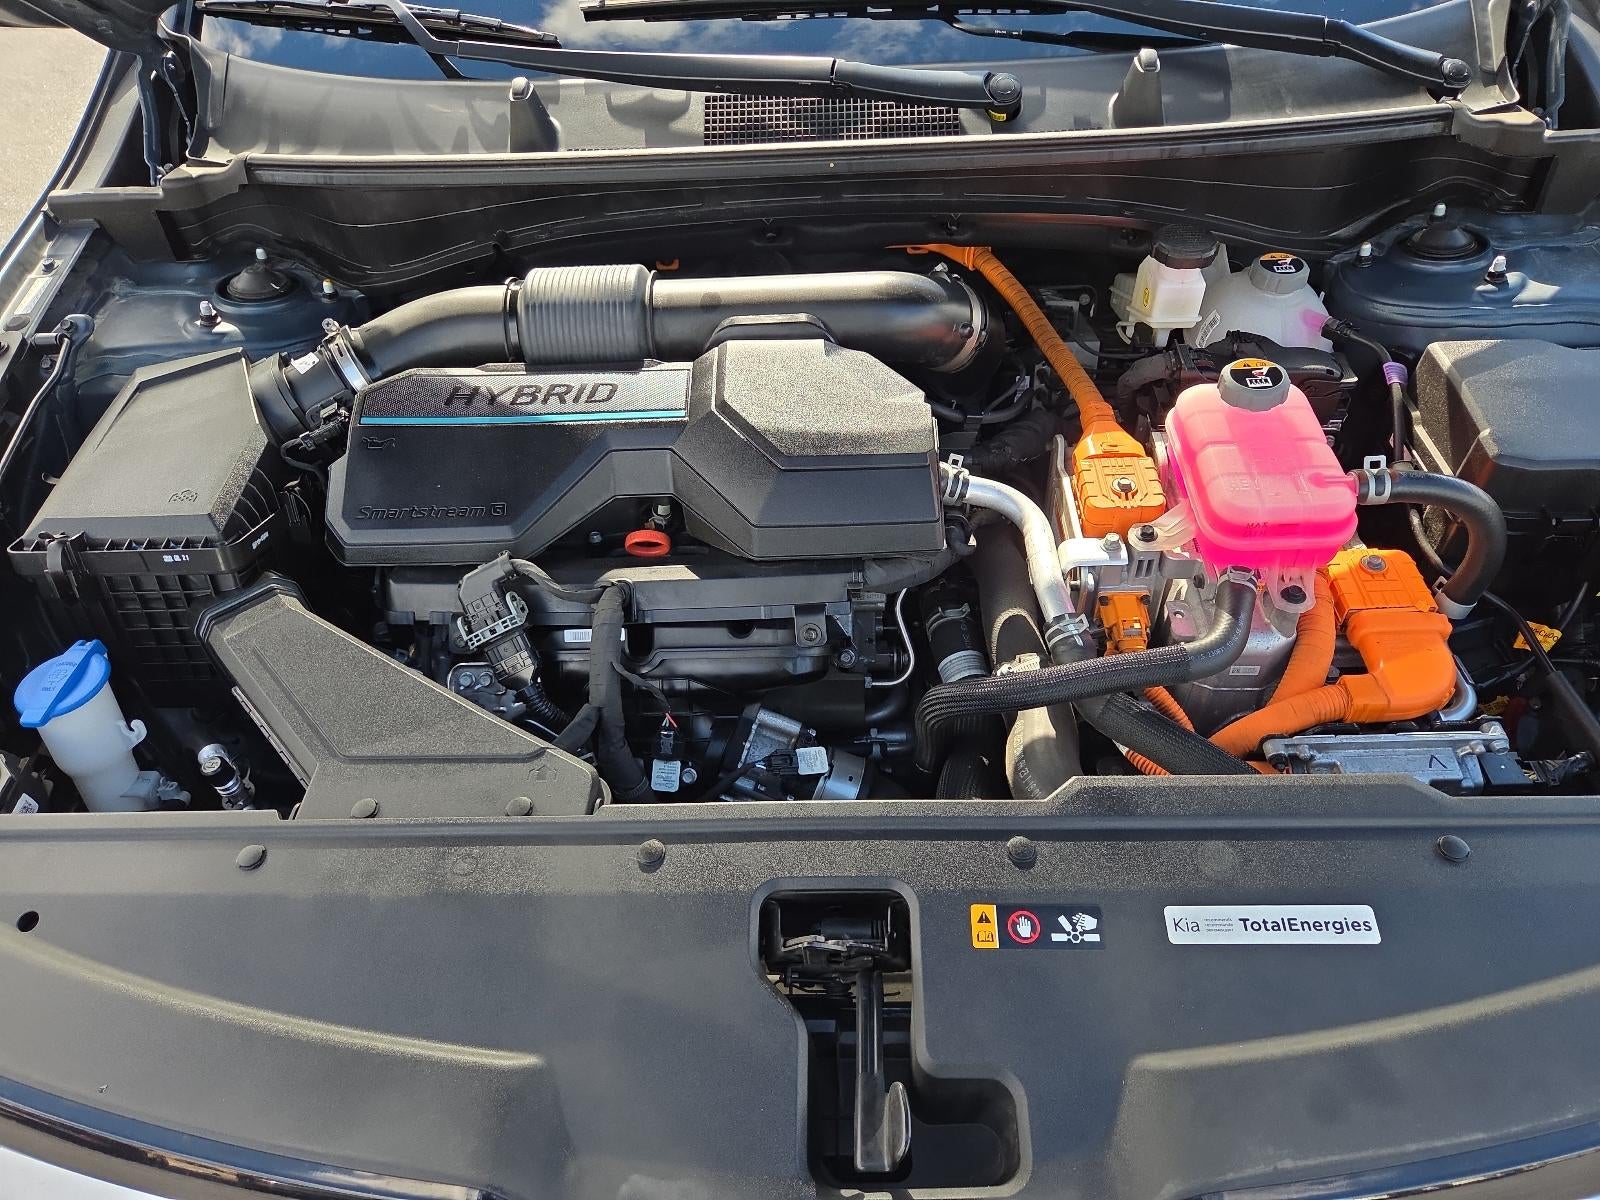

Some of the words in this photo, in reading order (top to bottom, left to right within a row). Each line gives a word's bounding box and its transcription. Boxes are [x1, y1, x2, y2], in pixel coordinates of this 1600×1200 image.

[444, 382, 619, 406] HYBRID
[355, 504, 486, 520] Smartstream
[1172, 917, 1201, 933] Kia
[1238, 917, 1373, 935] TotalEnergies
